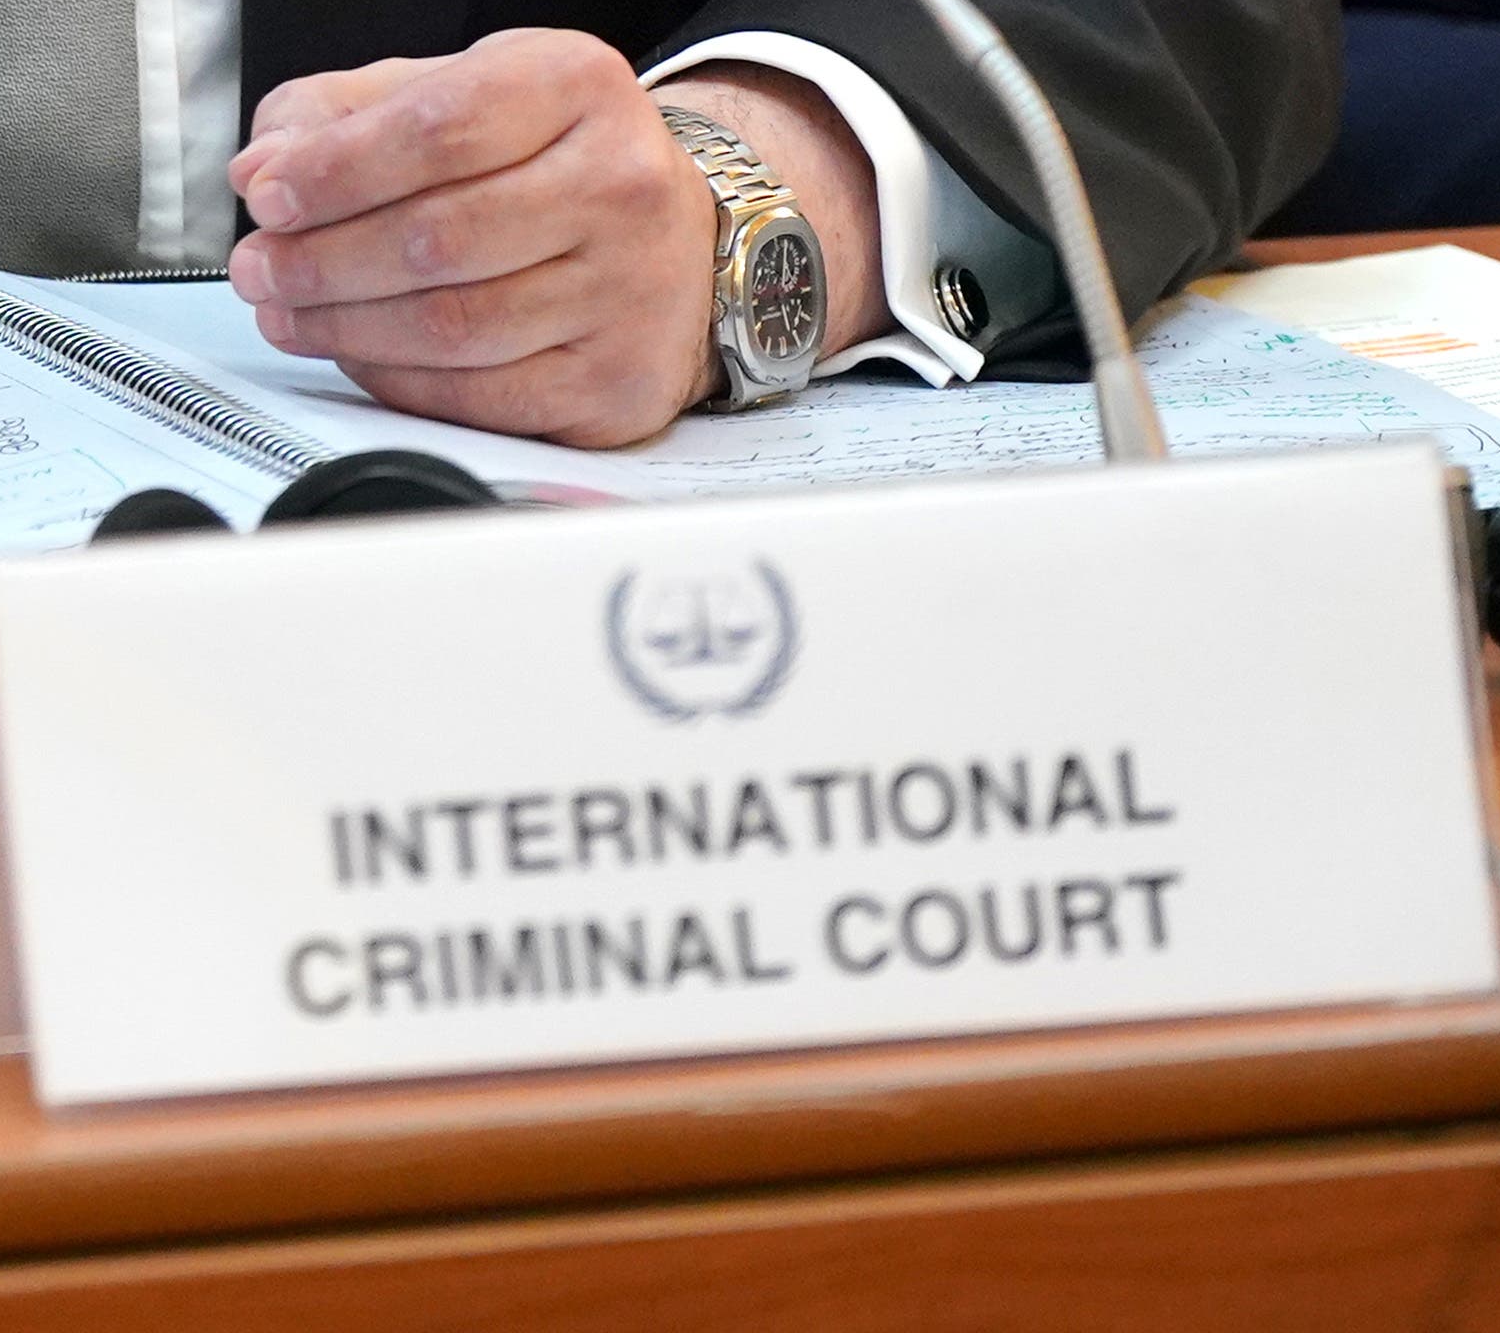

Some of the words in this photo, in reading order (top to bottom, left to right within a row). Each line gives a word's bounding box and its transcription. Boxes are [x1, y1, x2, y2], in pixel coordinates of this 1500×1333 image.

[328, 748, 1175, 883] INTERNATIONAL
[285, 902, 792, 1017] CRIMINAL
[823, 871, 1181, 976] COURT
